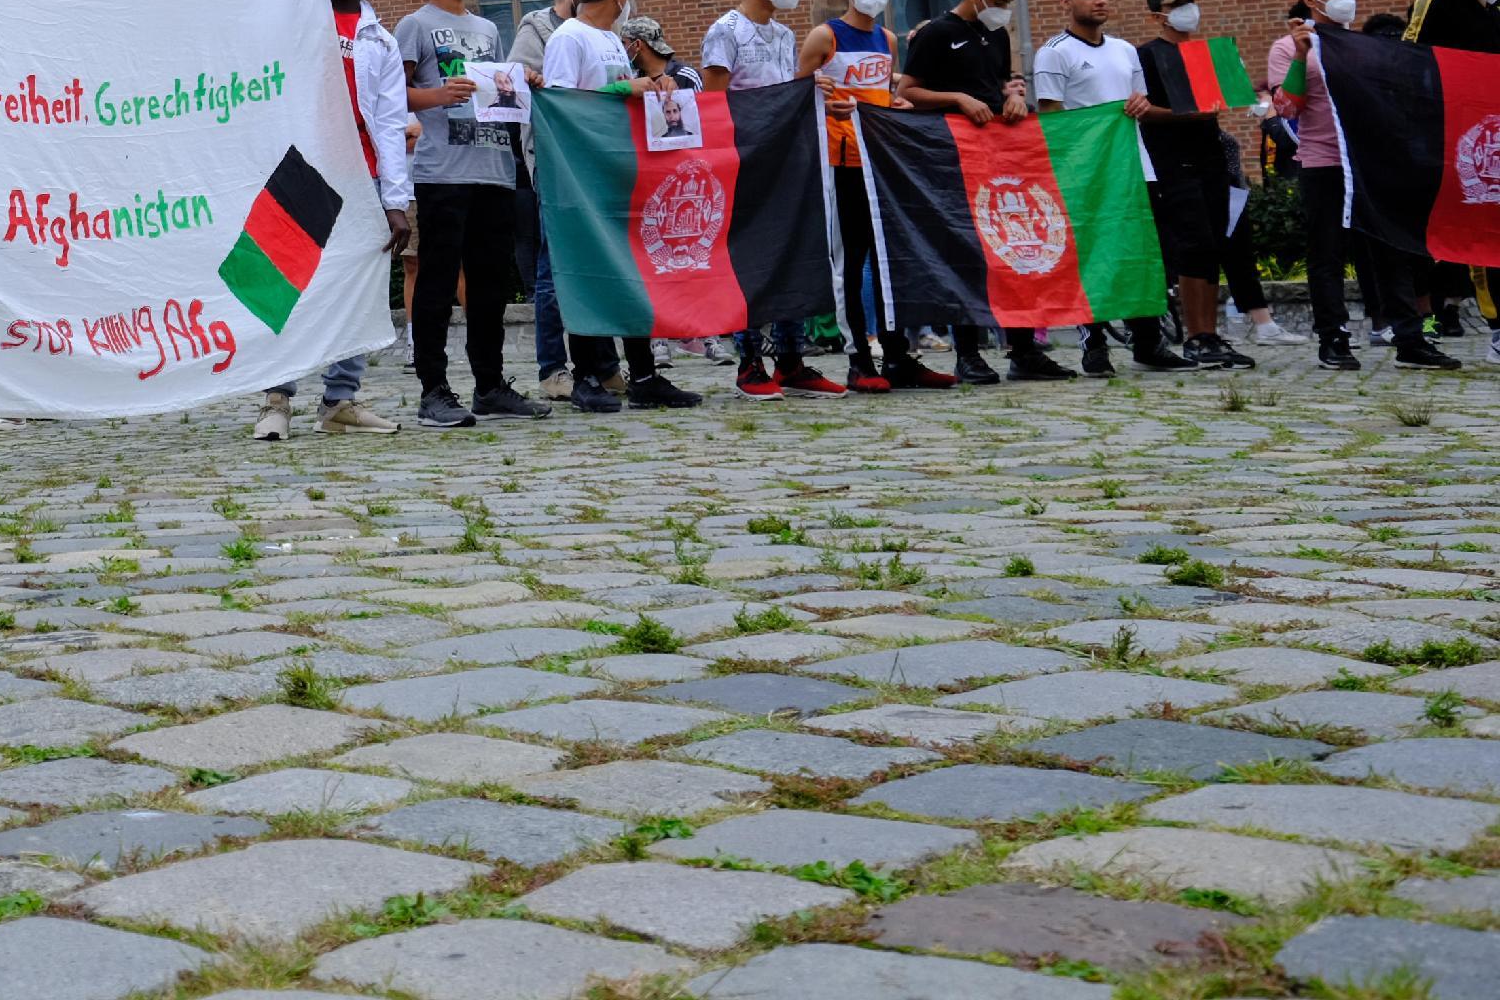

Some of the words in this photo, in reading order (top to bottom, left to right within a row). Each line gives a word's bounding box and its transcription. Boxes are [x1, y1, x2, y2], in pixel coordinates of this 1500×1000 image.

[95, 60, 286, 126] Gerechtigkeit
[3, 189, 213, 267] Afghanistan
[163, 298, 237, 375] Afg
